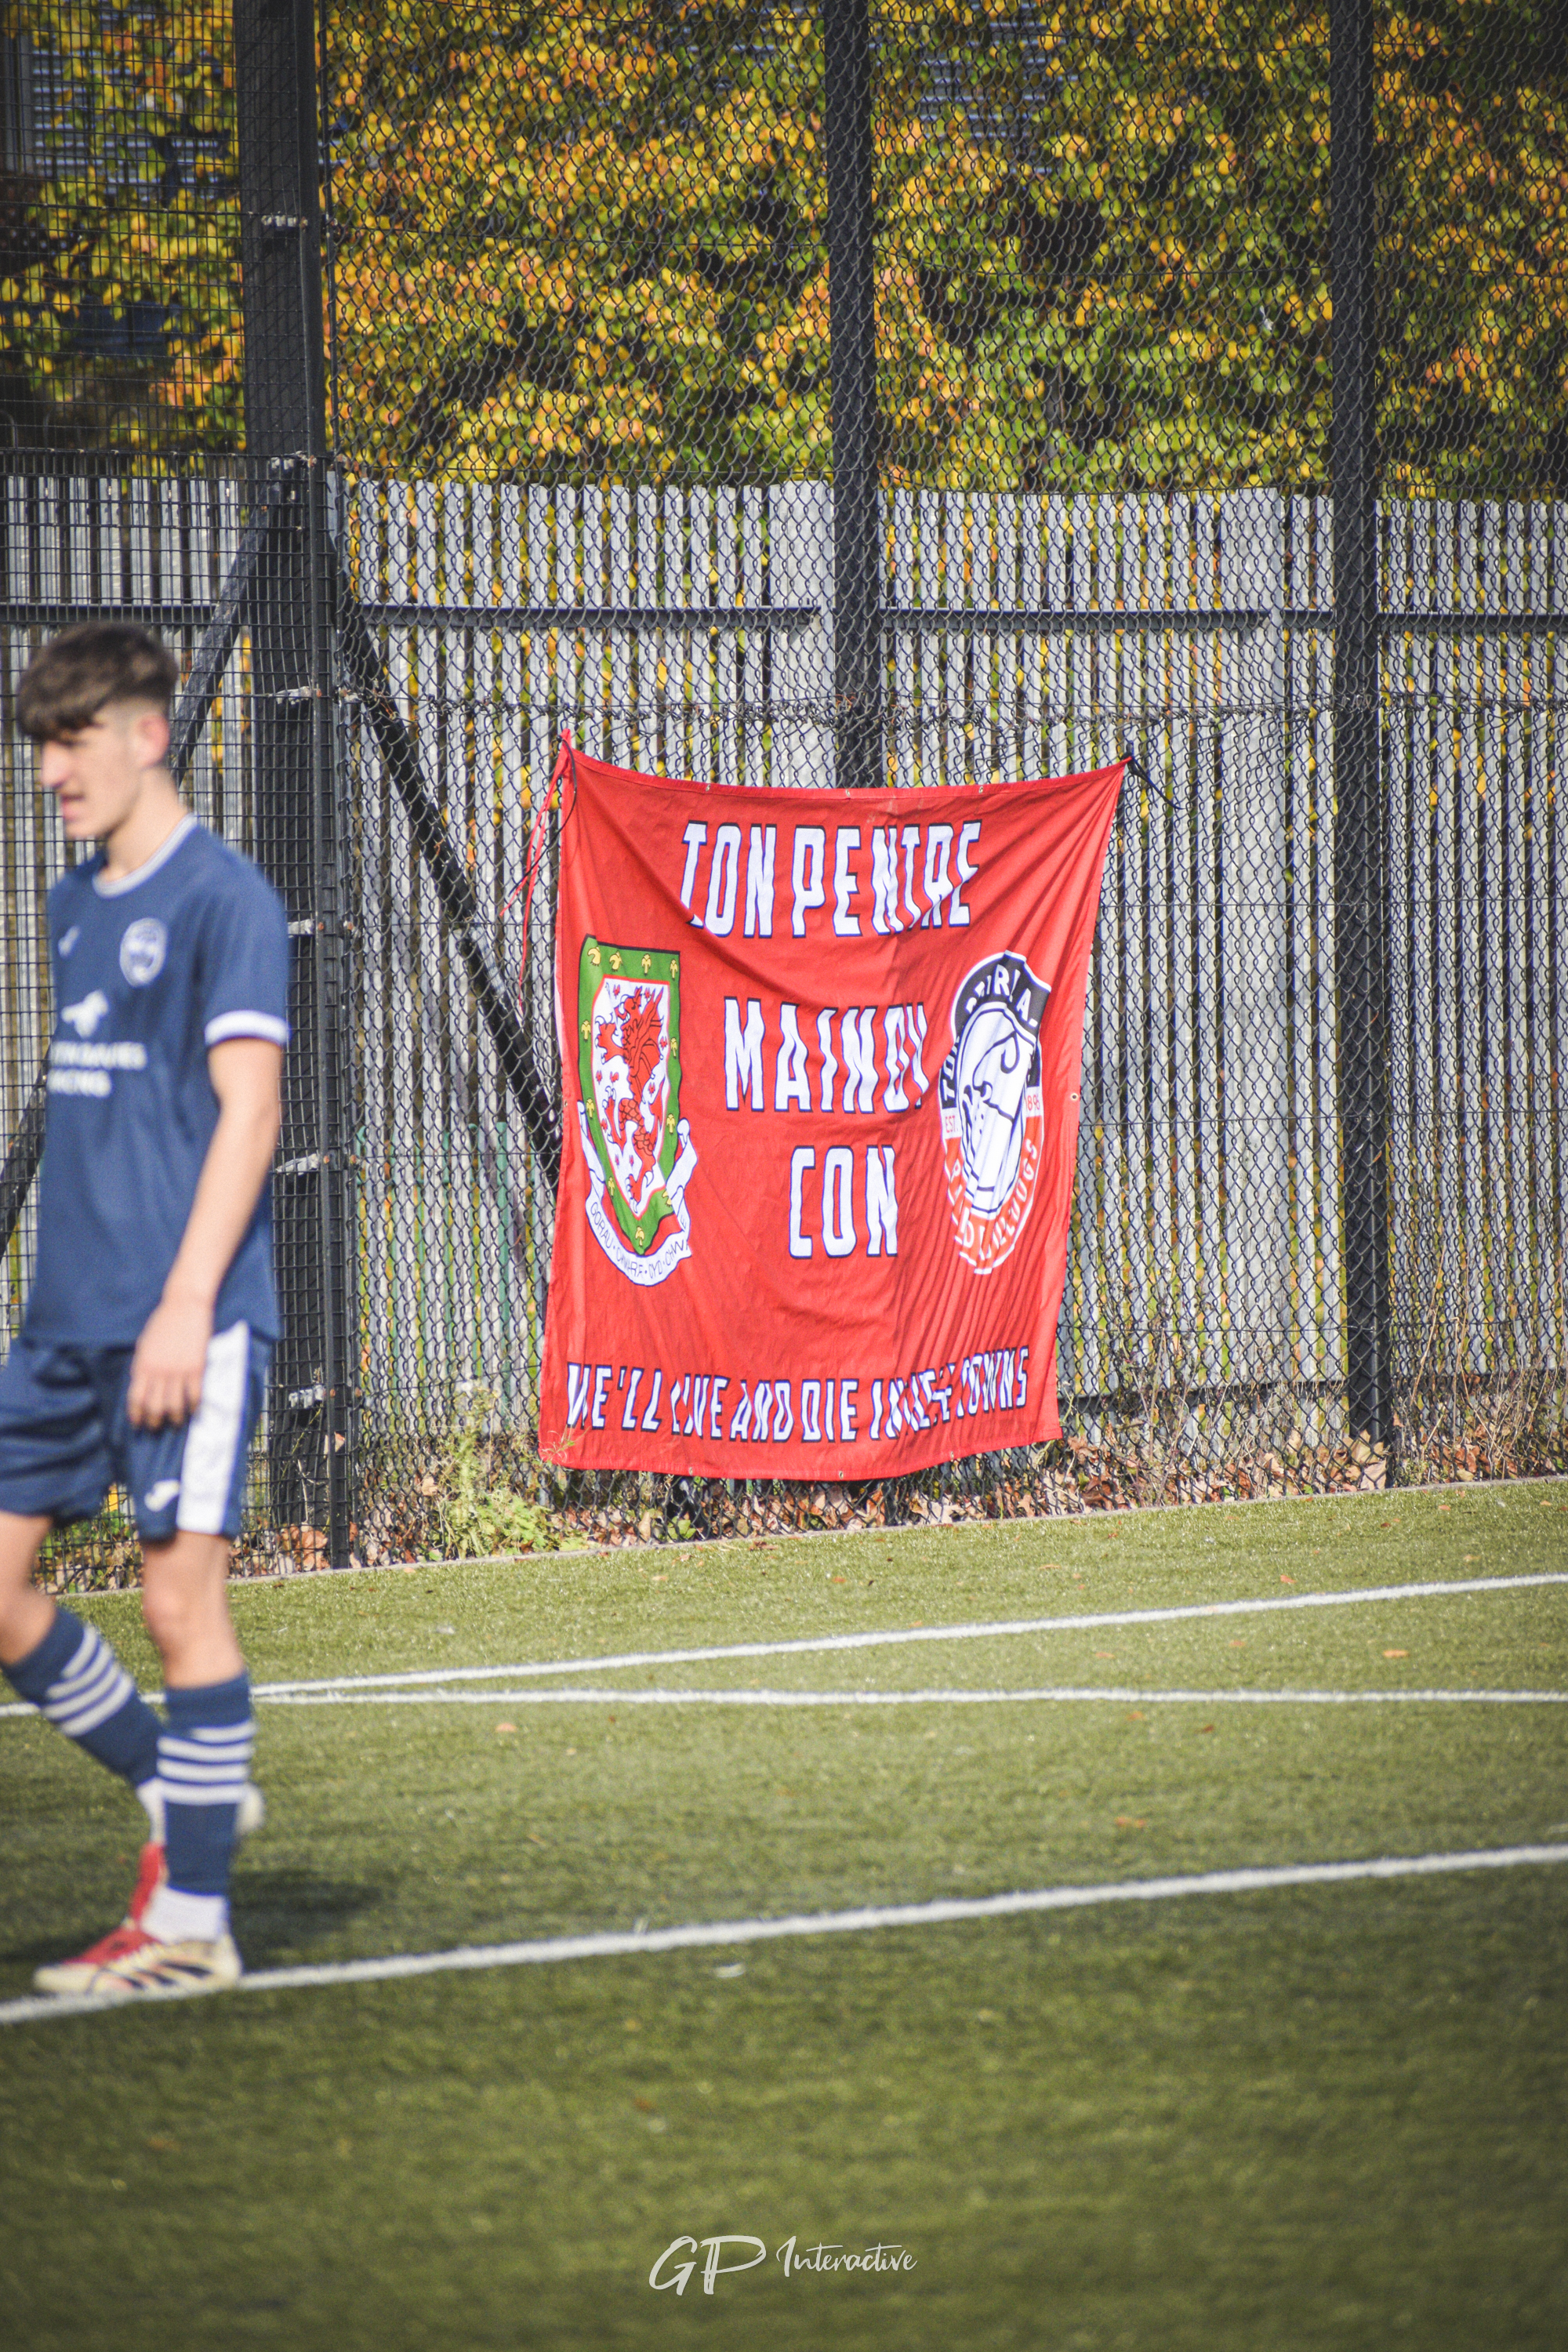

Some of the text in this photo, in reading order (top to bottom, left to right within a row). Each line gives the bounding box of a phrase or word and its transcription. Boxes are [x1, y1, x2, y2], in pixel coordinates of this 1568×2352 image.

[681, 818, 982, 938] TON PENTRE
[590, 1201, 613, 1249] GORAU
[789, 1145, 899, 1259] CON
[566, 1362, 662, 1432] WE'LL
[800, 1377, 859, 1443] DIE
